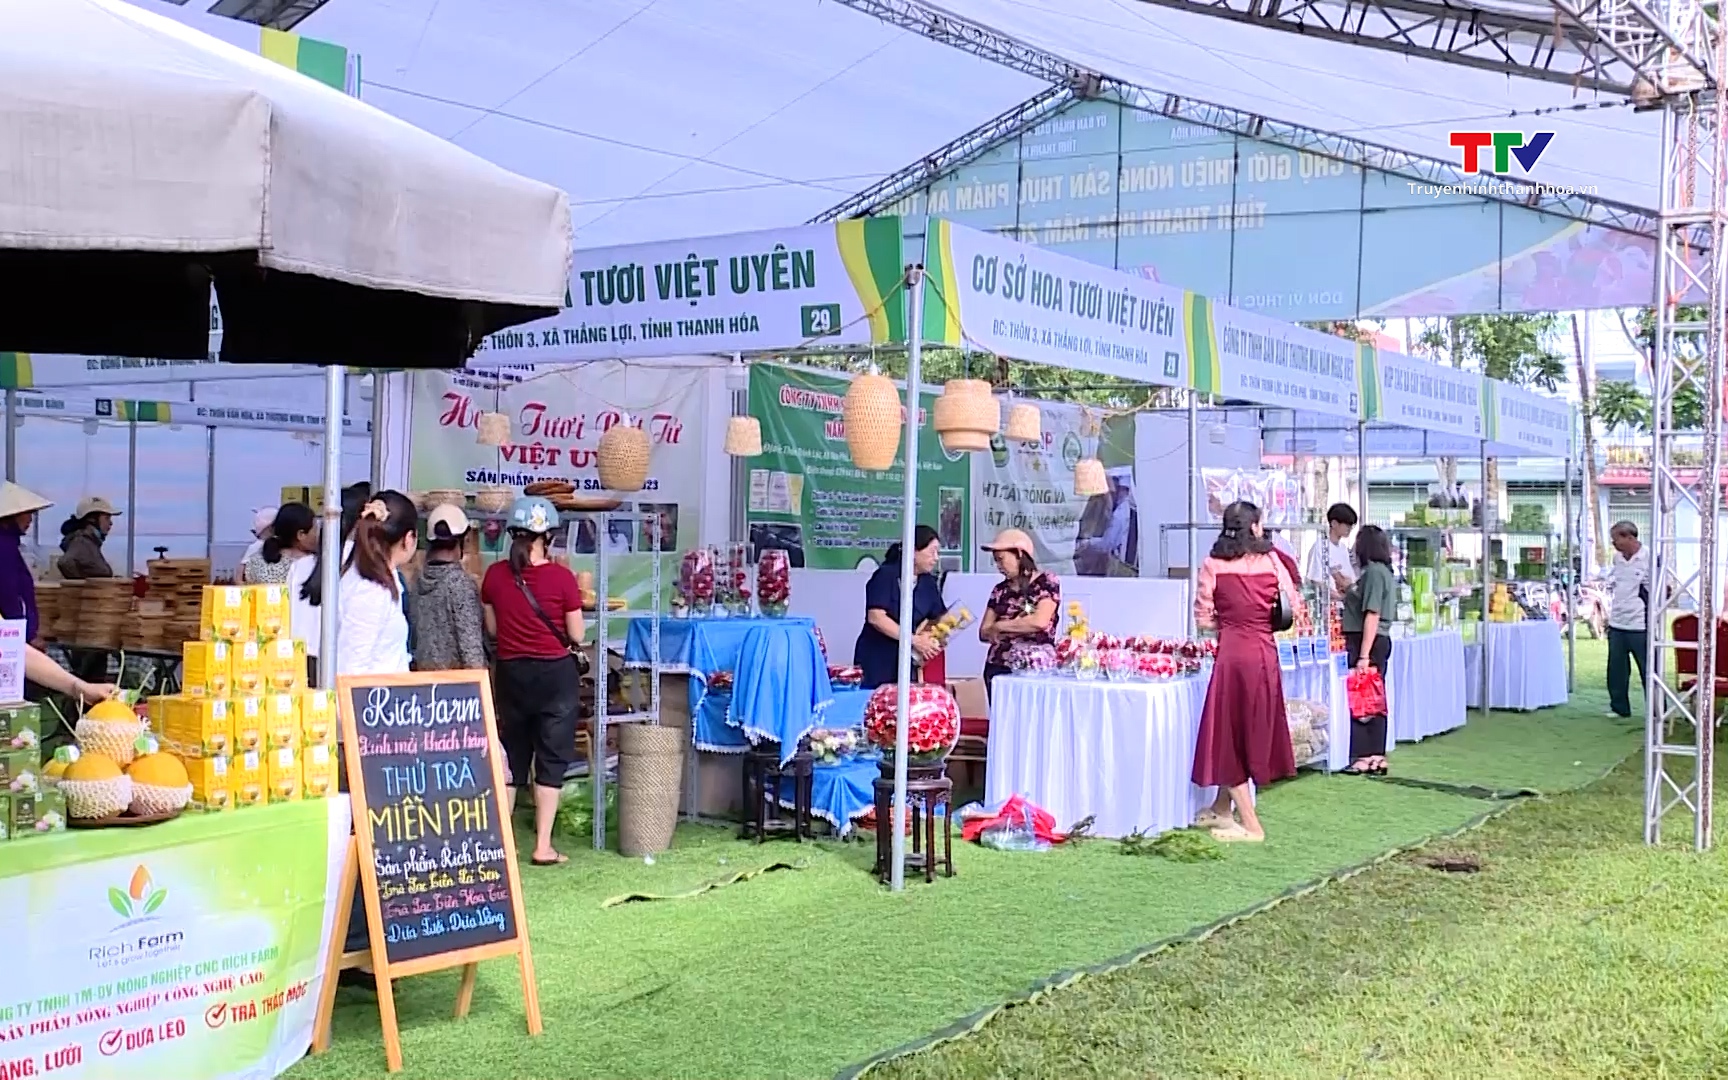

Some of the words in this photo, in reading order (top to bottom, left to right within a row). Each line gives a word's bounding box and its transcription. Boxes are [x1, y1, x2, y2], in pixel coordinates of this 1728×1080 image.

[581, 263, 645, 307] TƯƠI
[654, 253, 719, 306] VIỆT
[730, 243, 816, 294] UYÊN
[972, 253, 997, 295] CƠ
[1002, 253, 1027, 302] SỞ
[1031, 270, 1063, 312] HOA
[1069, 279, 1103, 320] TƯƠI
[1107, 287, 1137, 333] VIỆT
[1139, 297, 1175, 338] UYÊN
[491, 330, 523, 350] THÔN
[543, 327, 560, 346] XÃ
[640, 318, 674, 340] TỈNH
[677, 318, 725, 337] THANH
[811, 309, 831, 332] 29
[520, 402, 586, 440] Tươi
[500, 441, 561, 470] VIỆT
[466, 468, 497, 484] SẢN
[363, 686, 424, 727] Rich
[421, 729, 460, 752] khách
[382, 757, 426, 797] THỬ
[432, 755, 476, 791] TRÀ
[368, 796, 442, 844] MIỄN
[447, 788, 493, 834] PHÍ
[441, 841, 473, 868] Rich
[89, 942, 133, 960] Rich
[138, 929, 184, 950] Farm
[17, 1002, 32, 1018] TY
[37, 993, 71, 1013] TNHH
[151, 960, 192, 986] NGHIỆP
[30, 1010, 70, 1036] PHẨM
[116, 992, 160, 1016] NGHIỆP
[164, 985, 199, 1003] CÔNG
[203, 974, 235, 997] NGHỆ
[231, 999, 257, 1024] TRÀ
[126, 1025, 155, 1050] DƯA
[159, 1019, 186, 1042] LEO
[45, 1041, 82, 1072] LƯỚI
